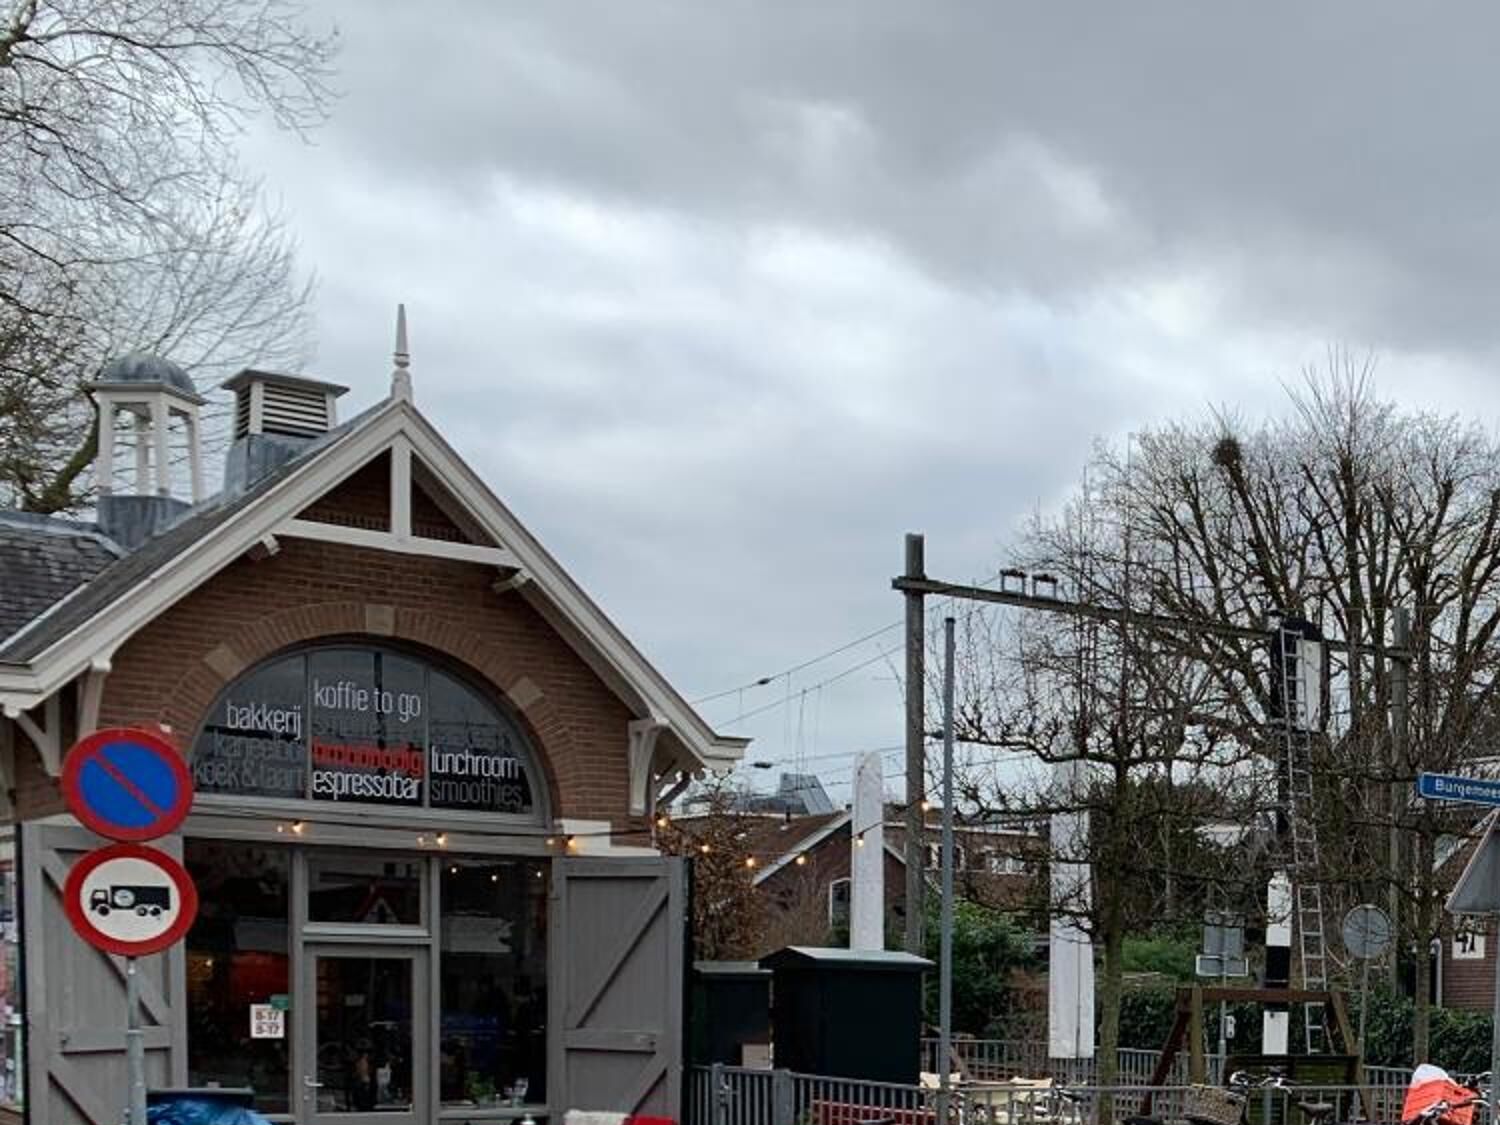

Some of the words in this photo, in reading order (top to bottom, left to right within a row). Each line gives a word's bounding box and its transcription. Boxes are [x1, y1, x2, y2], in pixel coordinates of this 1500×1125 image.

[314, 678, 368, 711] koffie
[374, 688, 393, 714] to
[398, 693, 421, 723] go
[227, 700, 301, 740] bakkerij
[431, 745, 519, 780] lunchroom
[313, 771, 420, 801] espressobar
[431, 777, 523, 805] smoothies
